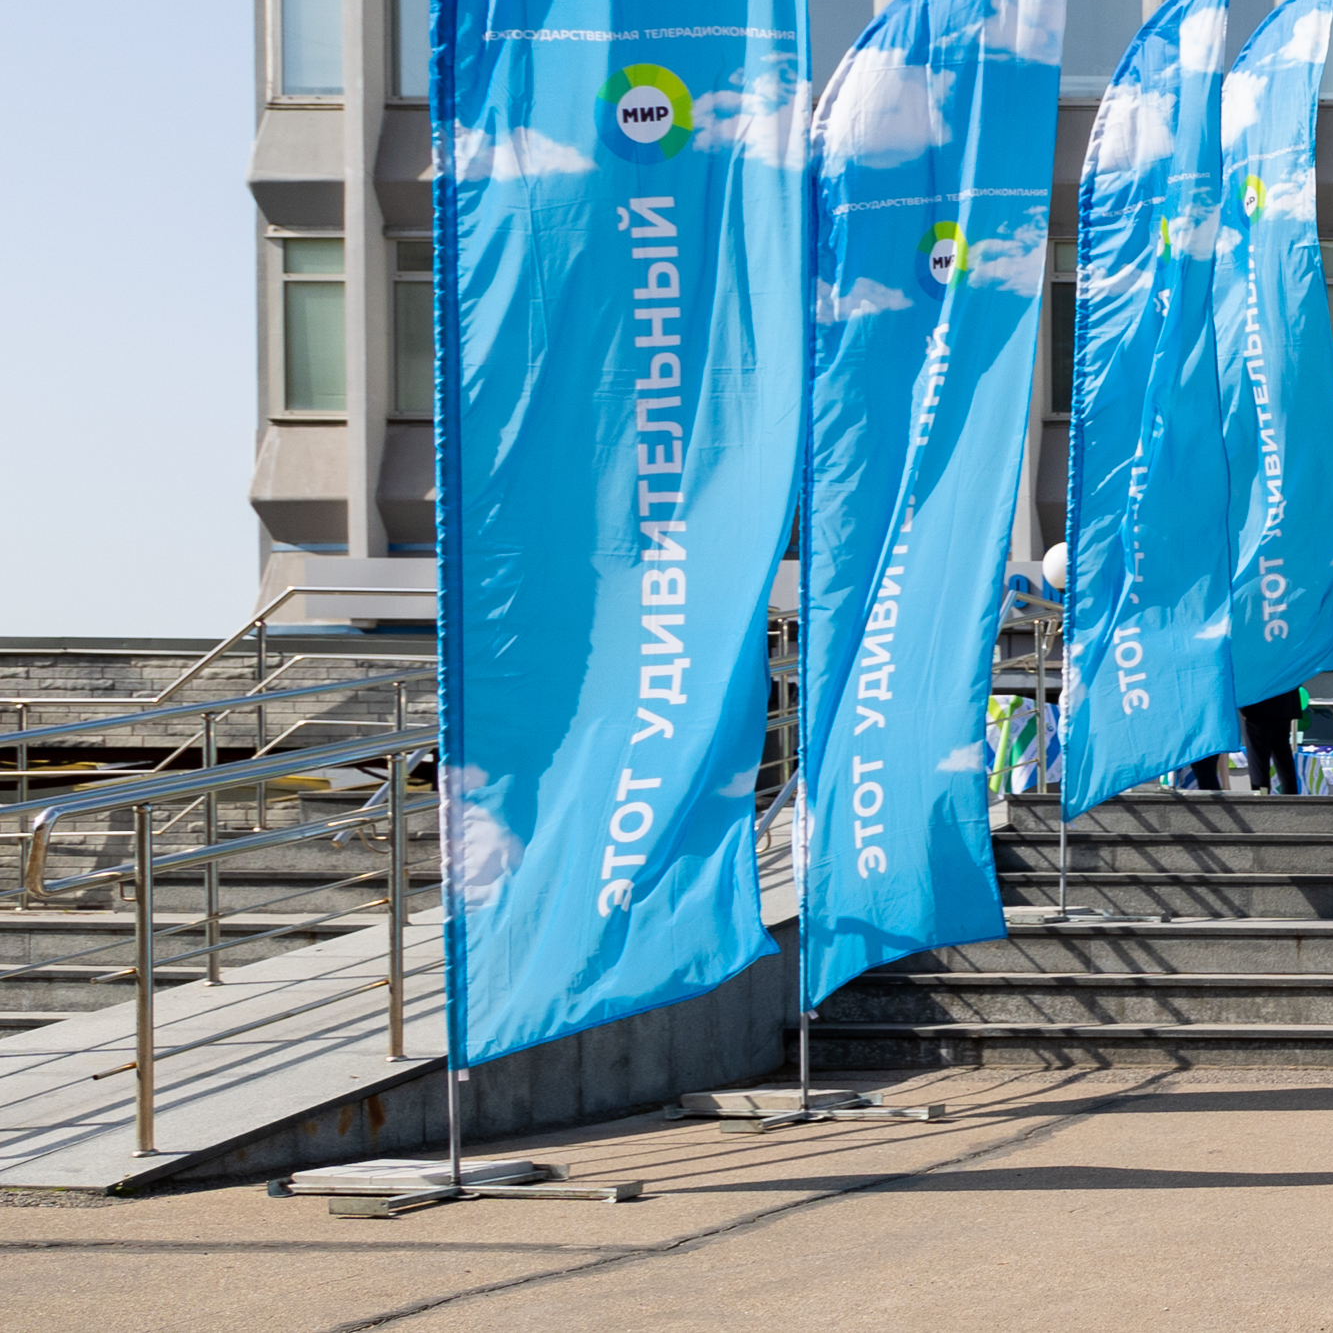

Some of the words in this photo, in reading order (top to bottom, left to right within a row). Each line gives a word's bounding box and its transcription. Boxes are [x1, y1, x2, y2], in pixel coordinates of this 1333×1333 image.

[643, 25, 796, 41] ТЕЛЕРАДИОКОМПАНИЯ
[622, 105, 669, 124] МИР
[616, 195, 692, 744] УДИВИТЕЛЬНЫЙ
[1258, 555, 1289, 643] ЭТОТ
[1114, 626, 1151, 715] ЭТОТ
[598, 768, 662, 918] ЭТОТ
[853, 755, 887, 880] ЭТОТ
